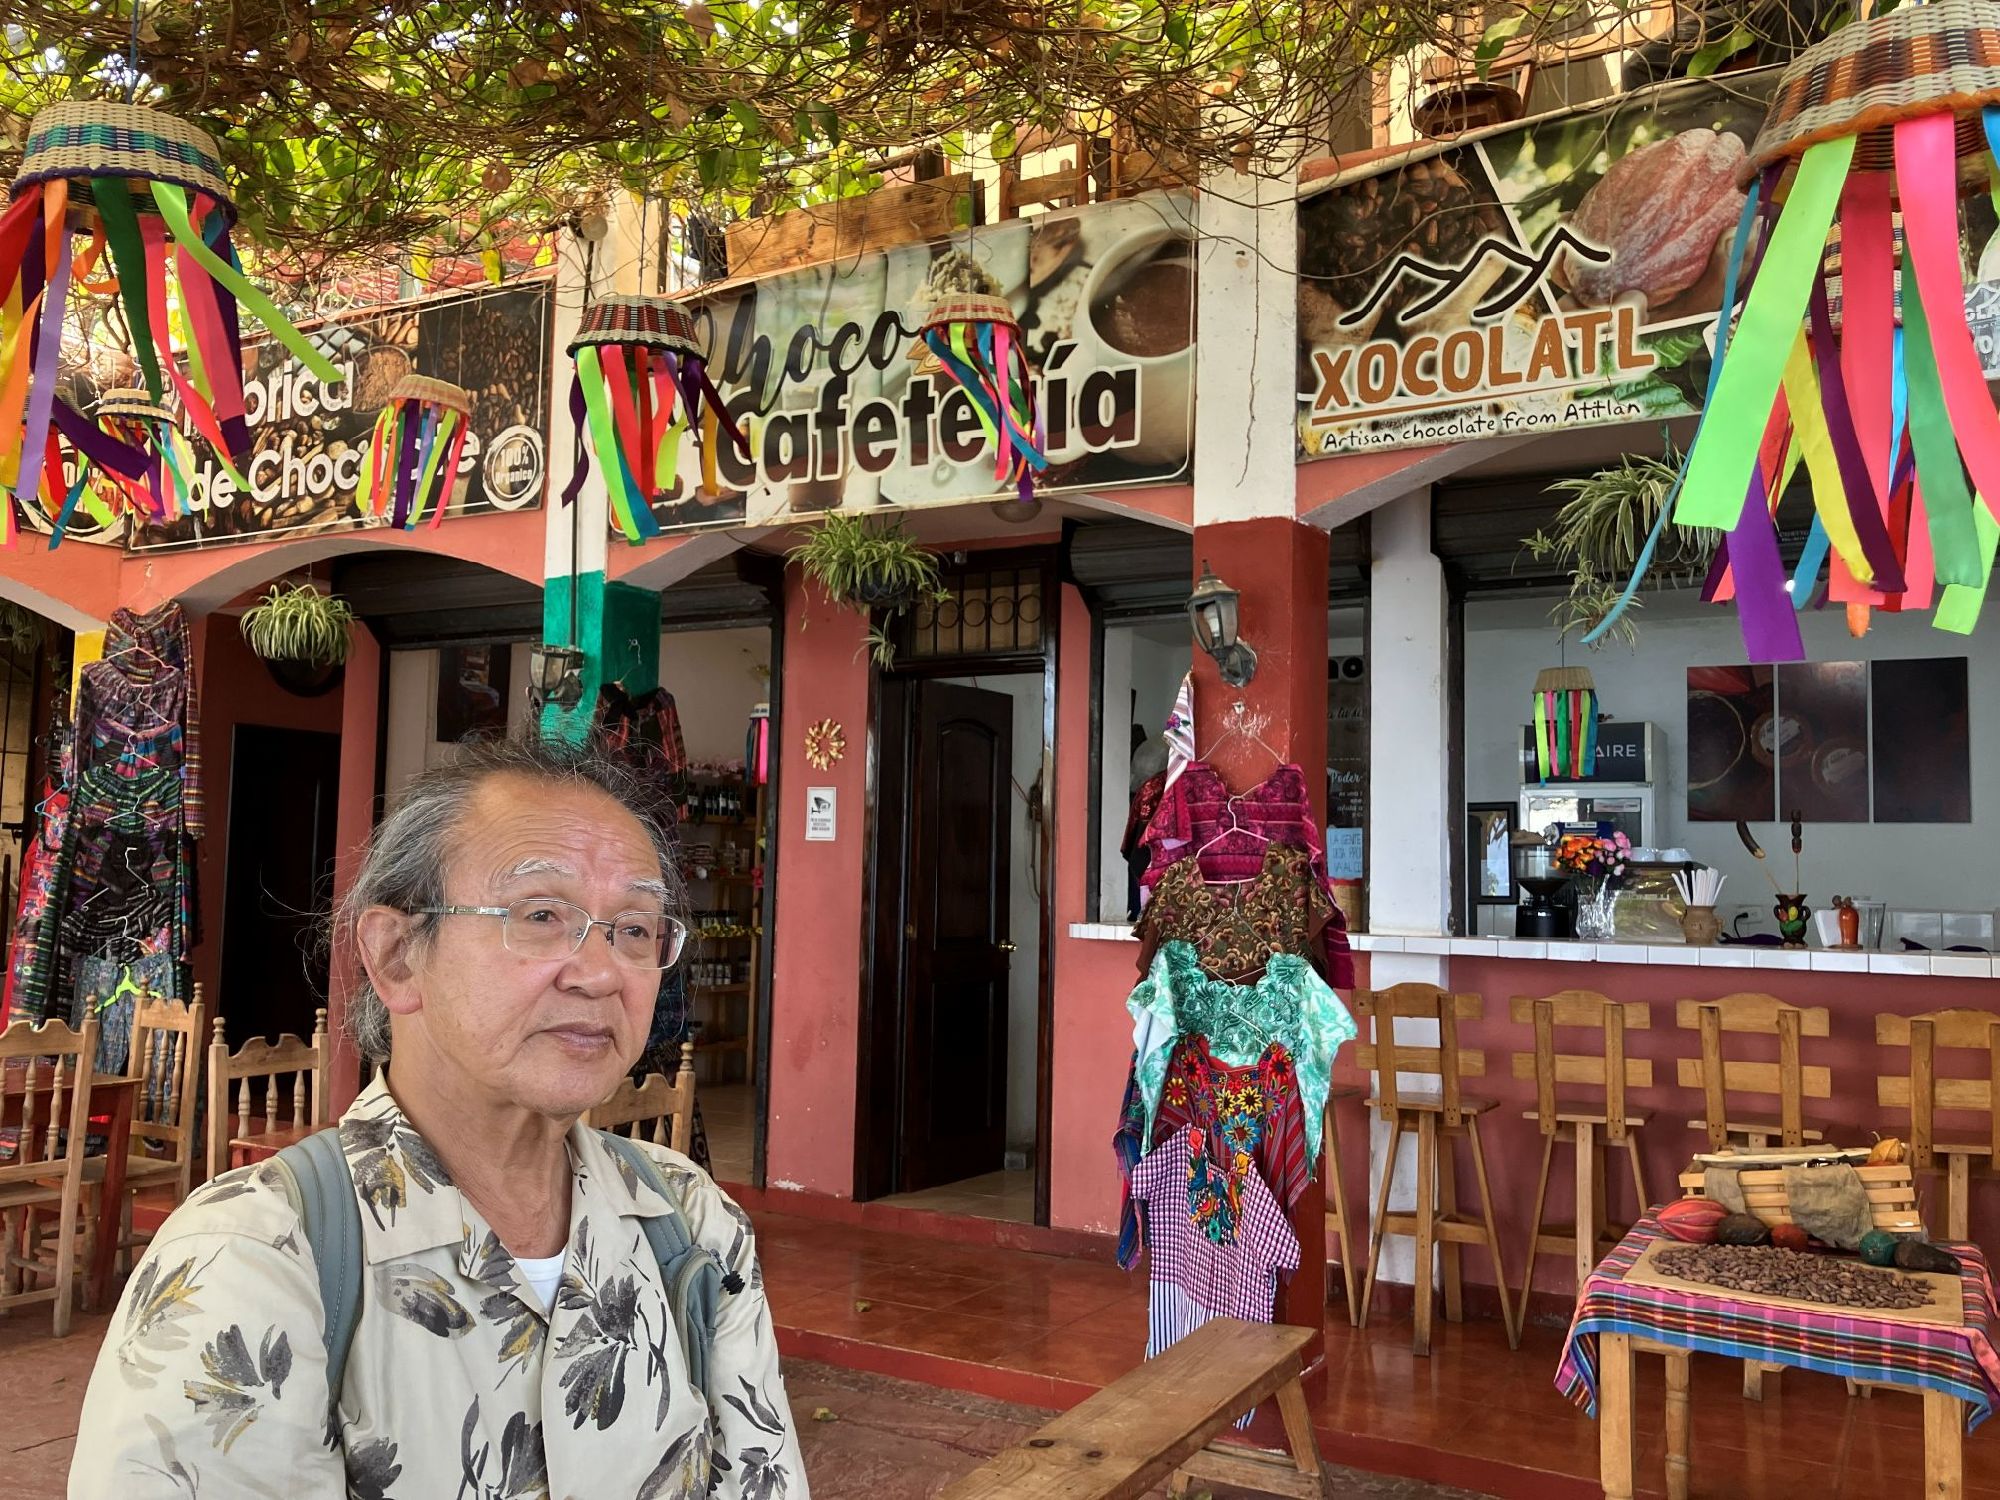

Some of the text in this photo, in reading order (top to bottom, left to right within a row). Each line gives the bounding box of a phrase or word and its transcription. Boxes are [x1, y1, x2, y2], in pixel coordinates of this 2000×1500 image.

[1314, 307, 1656, 411] XOCOLATL
[714, 341, 1140, 489] Cafeteía
[1323, 398, 1642, 451] Artisan chocolate from Atitlan
[500, 445, 530, 469] 100%
[187, 460, 238, 512] de
